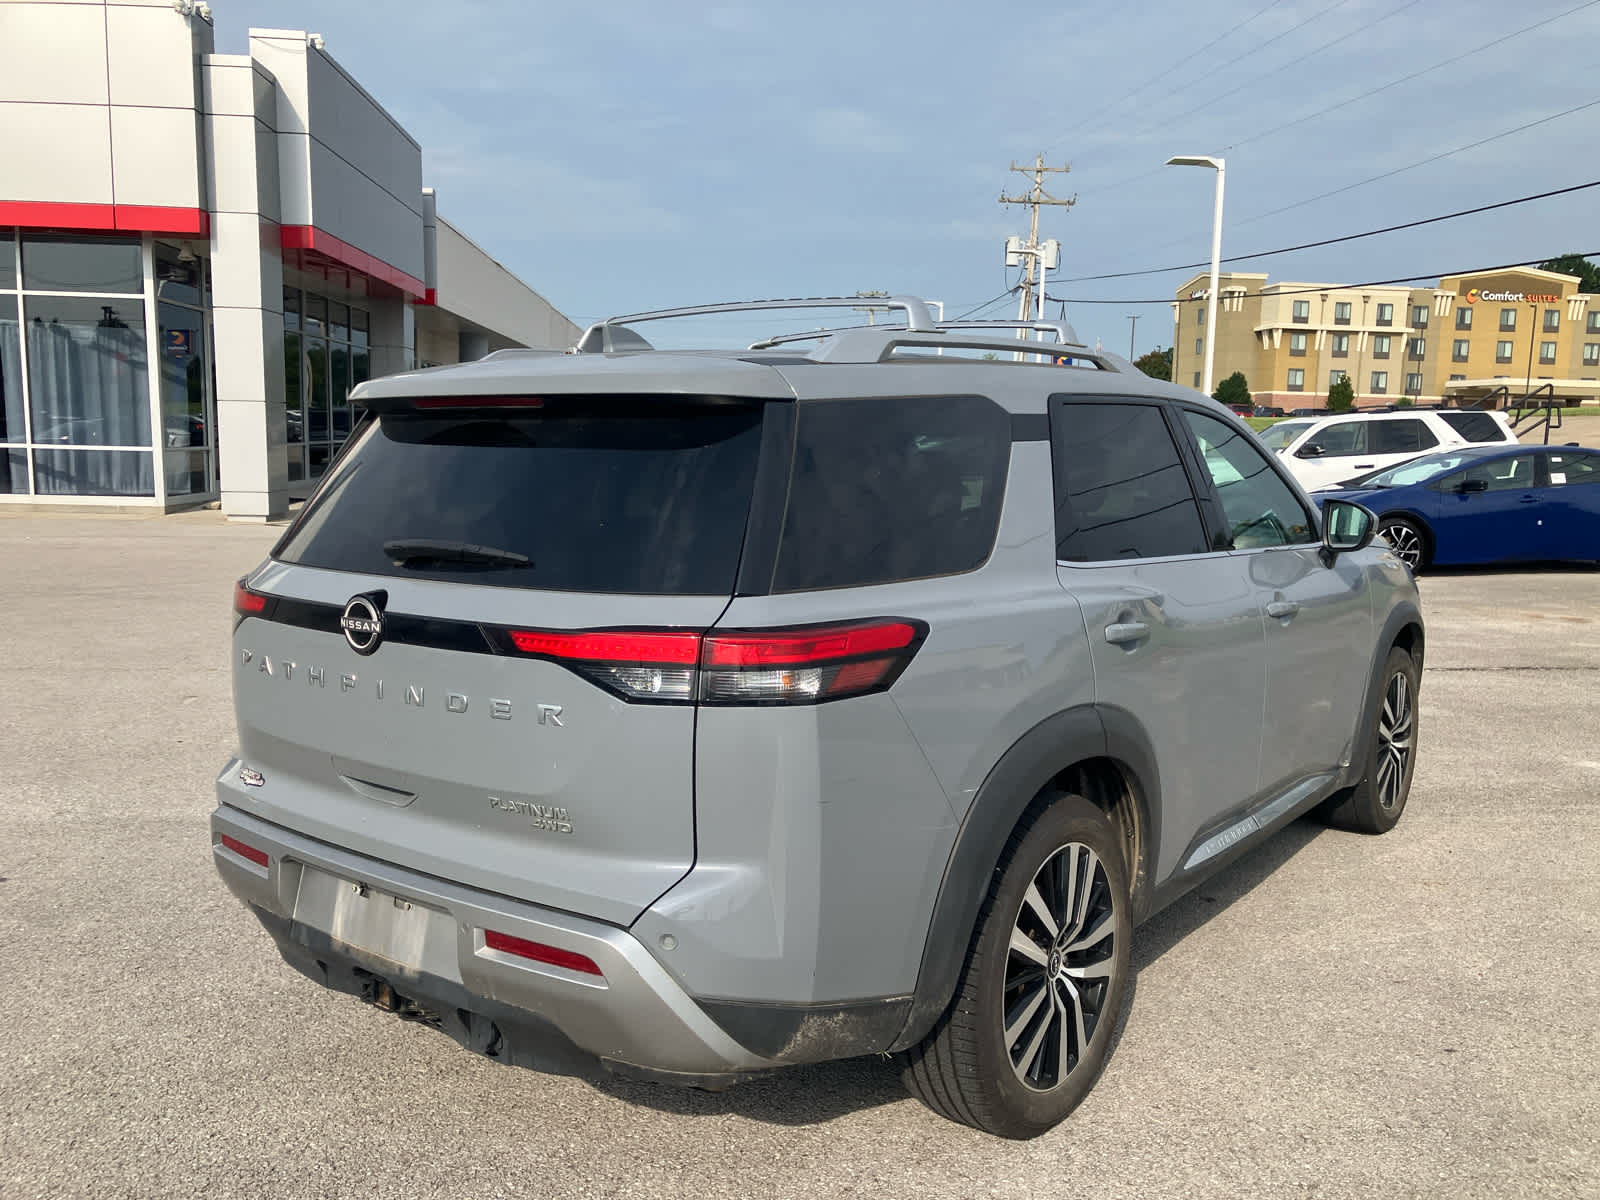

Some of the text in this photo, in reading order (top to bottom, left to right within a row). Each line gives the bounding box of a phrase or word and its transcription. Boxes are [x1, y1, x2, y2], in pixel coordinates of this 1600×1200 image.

[1481, 290, 1559, 303] Comfort SUITES
[340, 616, 381, 633] NISSAN
[241, 649, 565, 728] PATHFINDER
[488, 796, 569, 821] PLATINUM
[532, 818, 574, 834] 4WD
